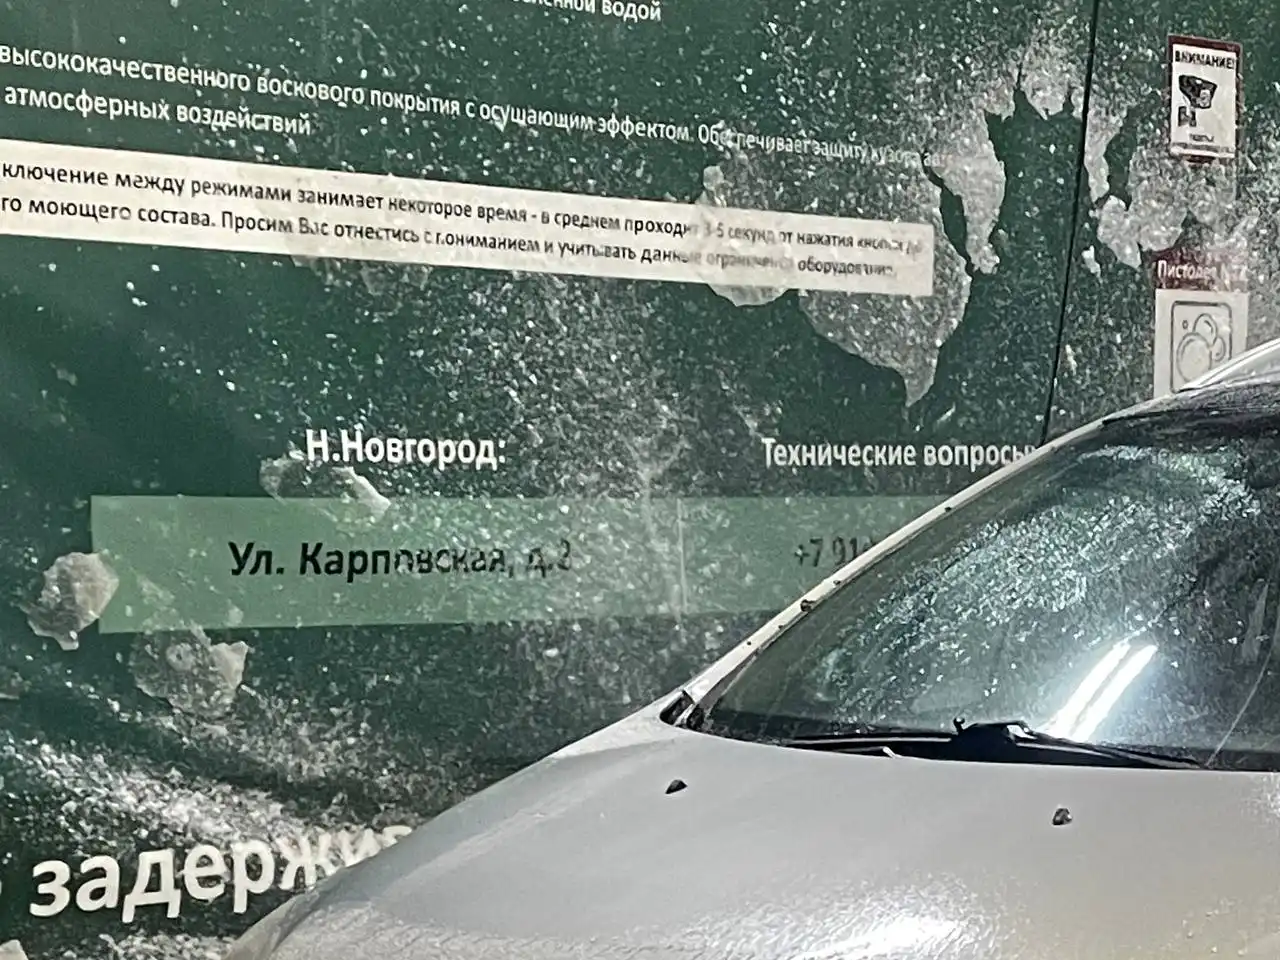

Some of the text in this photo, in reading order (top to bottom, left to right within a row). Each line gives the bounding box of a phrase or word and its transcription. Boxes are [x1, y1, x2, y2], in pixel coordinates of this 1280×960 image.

[602, 0, 661, 23] водой
[0, 45, 250, 92] высококачественного
[257, 76, 364, 105] воскового
[371, 89, 460, 115] покрытия
[465, 101, 475, 118] с
[480, 102, 594, 135] осушающим
[598, 113, 694, 143] эффектом.
[4, 85, 311, 136] атмосферных воздействий
[3, 162, 108, 187] ключение
[115, 172, 185, 195] между
[192, 178, 291, 202] режимами
[298, 189, 384, 210] занимает
[389, 196, 472, 219] некоторое
[478, 205, 527, 223] время
[541, 211, 549, 225] в
[554, 212, 621, 231] среднем
[728, 226, 776, 245] секунд
[779, 230, 793, 244] от
[796, 231, 854, 248] нажатия
[29, 199, 131, 223] моющего
[138, 207, 216, 227] состава.
[222, 211, 292, 235] Просим
[334, 223, 419, 243] отнестись
[544, 240, 553, 254] и
[306, 429, 506, 471] Н.Новгород:
[761, 437, 916, 468] Технические
[229, 541, 285, 576] Ул.
[300, 542, 514, 583] Карповская,
[832, 536, 872, 563] 91
[29, 825, 413, 924] задержи
